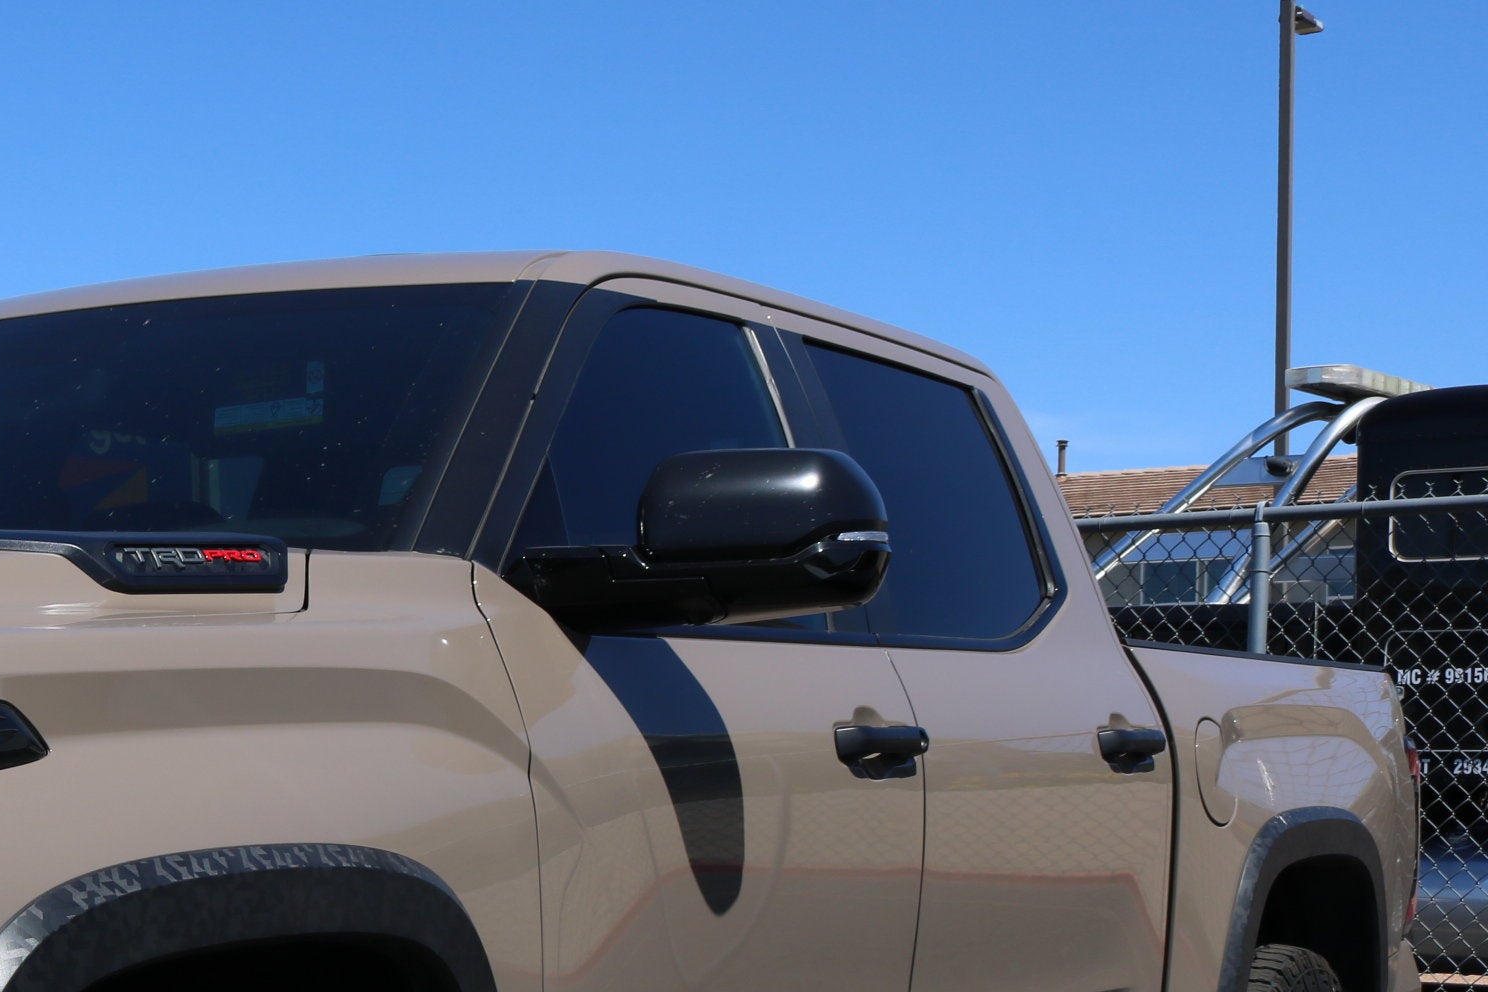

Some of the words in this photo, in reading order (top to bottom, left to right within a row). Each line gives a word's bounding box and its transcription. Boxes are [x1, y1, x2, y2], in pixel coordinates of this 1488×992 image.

[123, 546, 204, 569] TRD
[202, 549, 262, 563] PRO
[1397, 669, 1421, 685] MC
